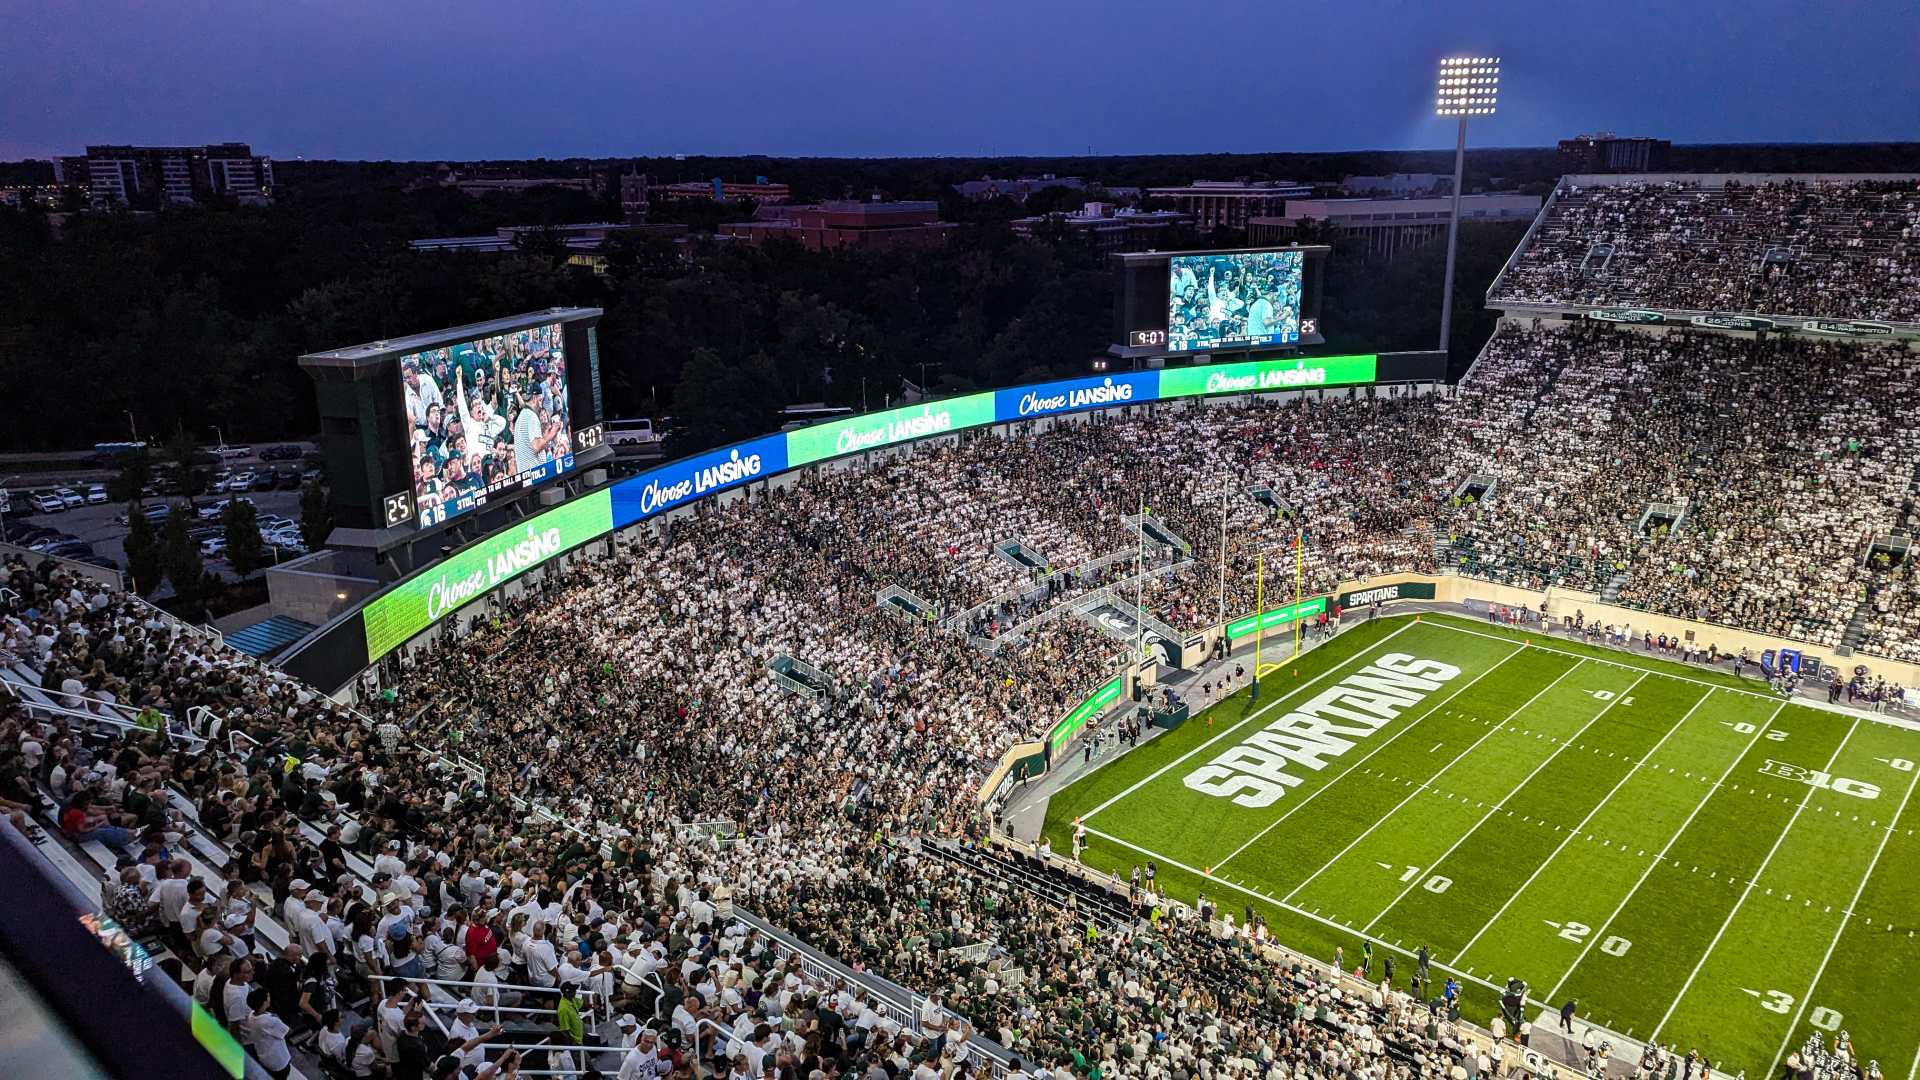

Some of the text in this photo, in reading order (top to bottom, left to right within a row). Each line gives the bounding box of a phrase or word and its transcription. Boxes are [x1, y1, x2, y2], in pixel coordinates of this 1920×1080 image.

[1138, 331, 1164, 345] 9:07
[1301, 320, 1315, 333] 25
[1207, 370, 1257, 393] Choose
[1020, 391, 1067, 415] Choose
[578, 426, 603, 448] 9:07
[838, 426, 885, 453] Choose
[556, 459, 563, 474] 0
[640, 479, 693, 513] Choose
[388, 496, 409, 522] 25
[432, 503, 446, 524] 16
[427, 569, 484, 620] Choose
[1349, 586, 1399, 606] SPARTANS
[1182, 652, 1462, 808] SPARTANS
